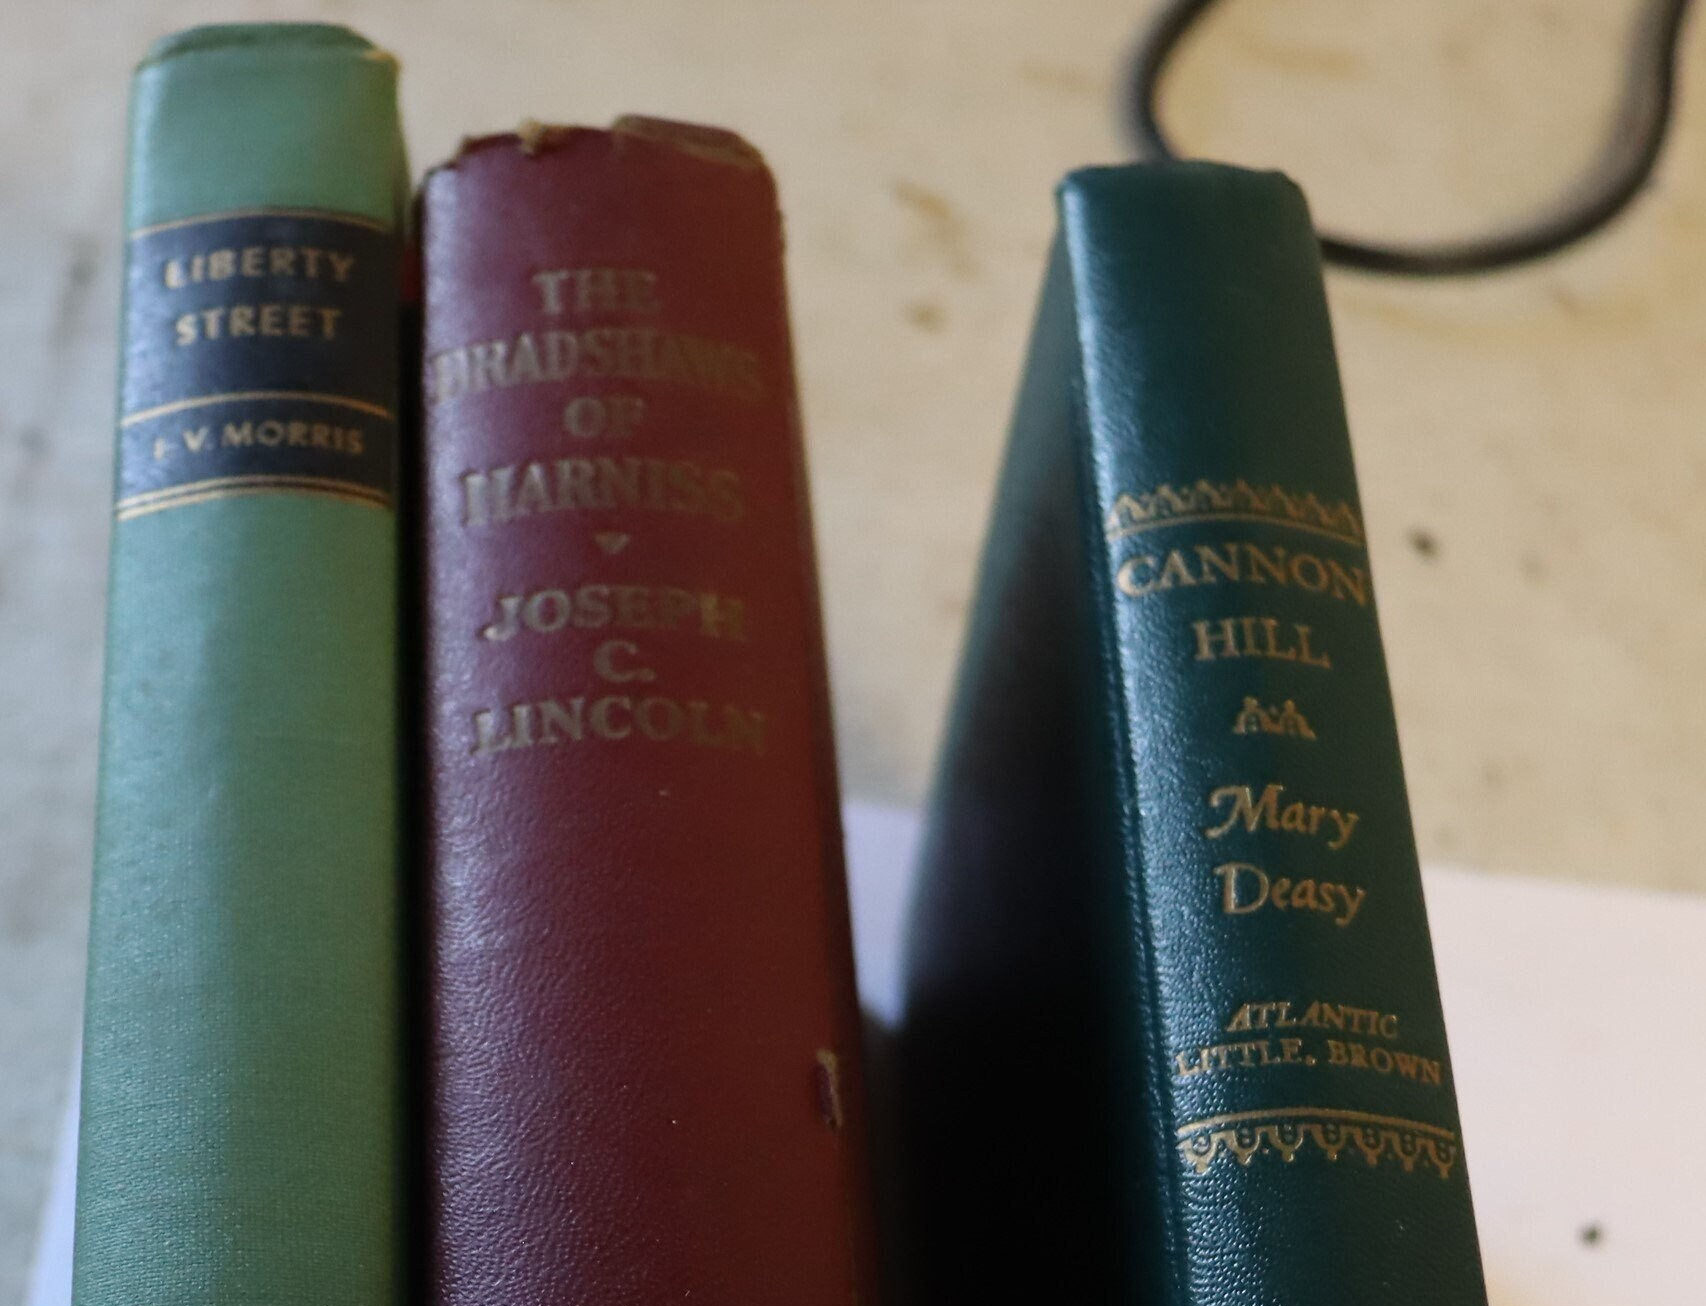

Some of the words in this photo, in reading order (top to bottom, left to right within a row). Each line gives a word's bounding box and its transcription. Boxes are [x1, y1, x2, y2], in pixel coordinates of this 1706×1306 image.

[163, 247, 355, 289] LIBERTY
[531, 267, 660, 316] THE
[175, 303, 341, 346] STREET
[221, 420, 365, 454] MORRIS
[563, 395, 648, 440] OF
[1116, 541, 1366, 606] CANNON
[482, 583, 747, 641] JOSEPH
[1192, 615, 1332, 669] HILL
[472, 695, 768, 757] LINCOLN
[1206, 784, 1359, 850] Mary
[1213, 861, 1367, 928] Deasy
[1225, 1000, 1400, 1038] ATLANTIC
[1327, 1038, 1443, 1086] BROWN
